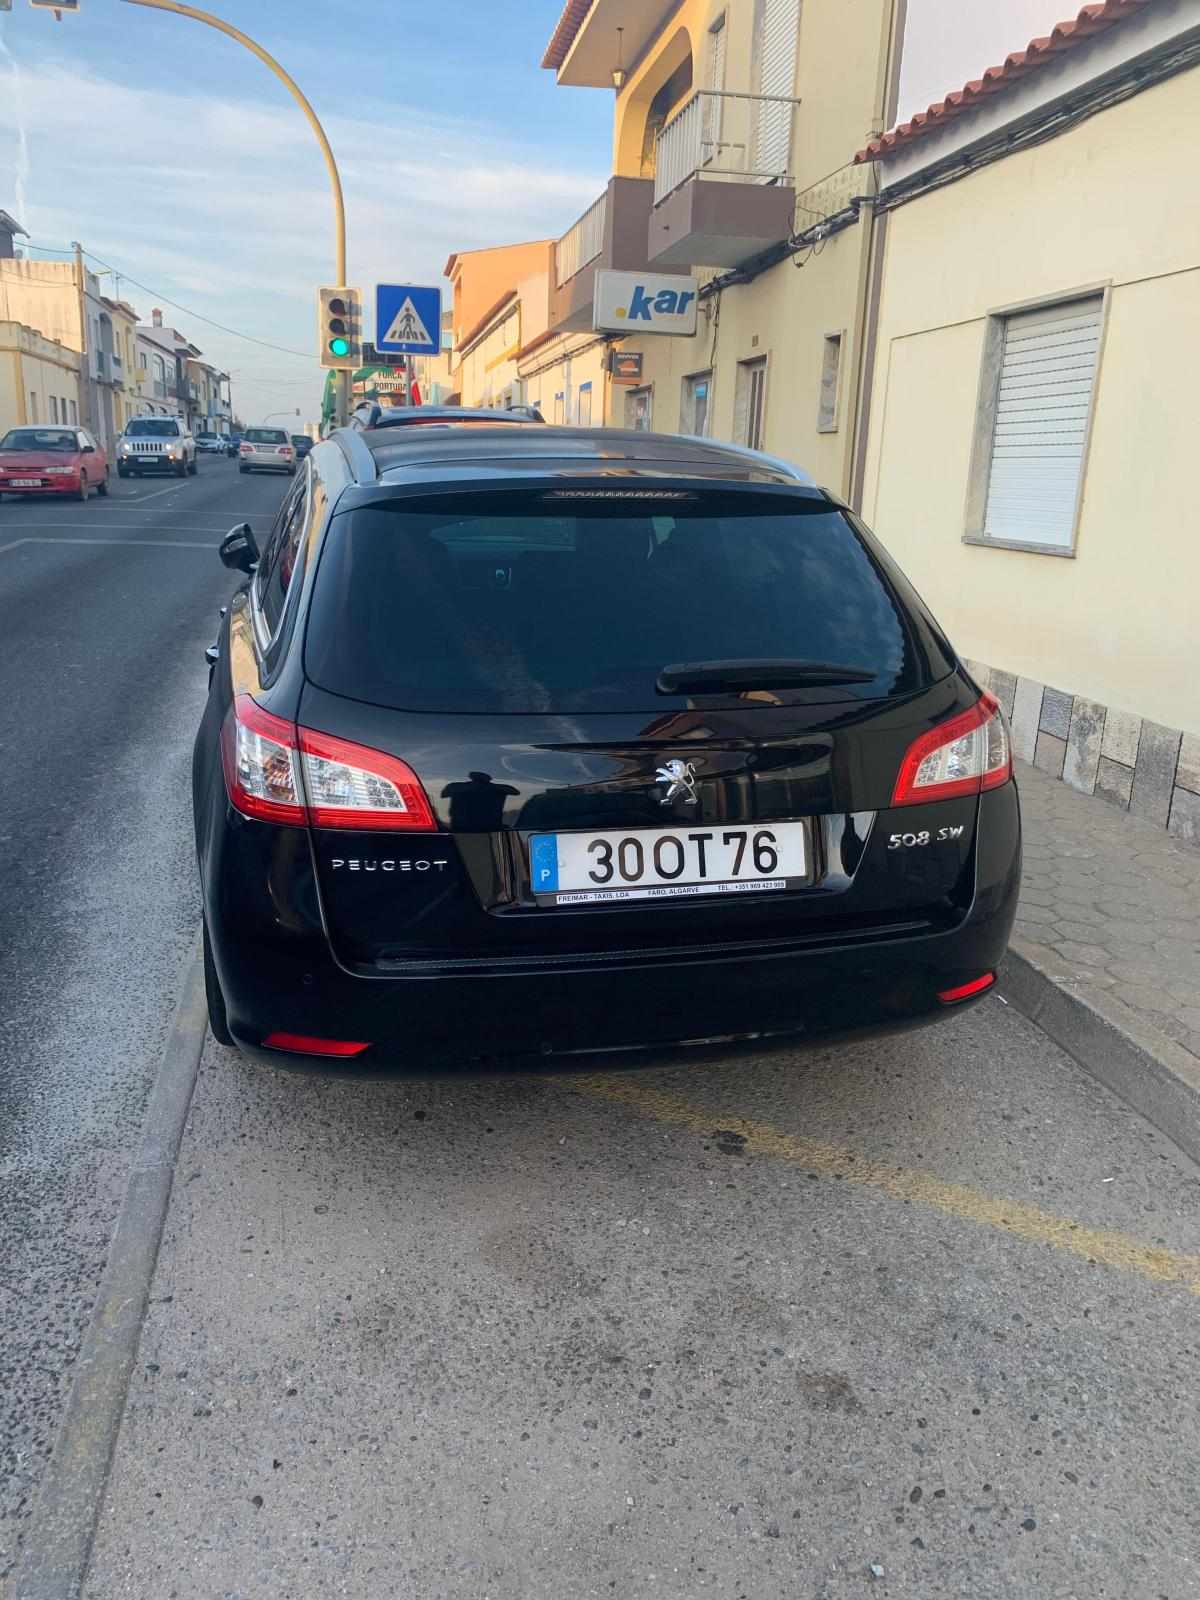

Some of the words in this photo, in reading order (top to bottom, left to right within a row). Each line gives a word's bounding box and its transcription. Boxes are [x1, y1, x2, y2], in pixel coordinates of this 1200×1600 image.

[887, 831, 931, 849] 508
[936, 825, 963, 841] SW
[331, 859, 448, 871] PEUGEOT
[541, 869, 551, 882] P
[669, 886, 700, 895] ALGARVE
